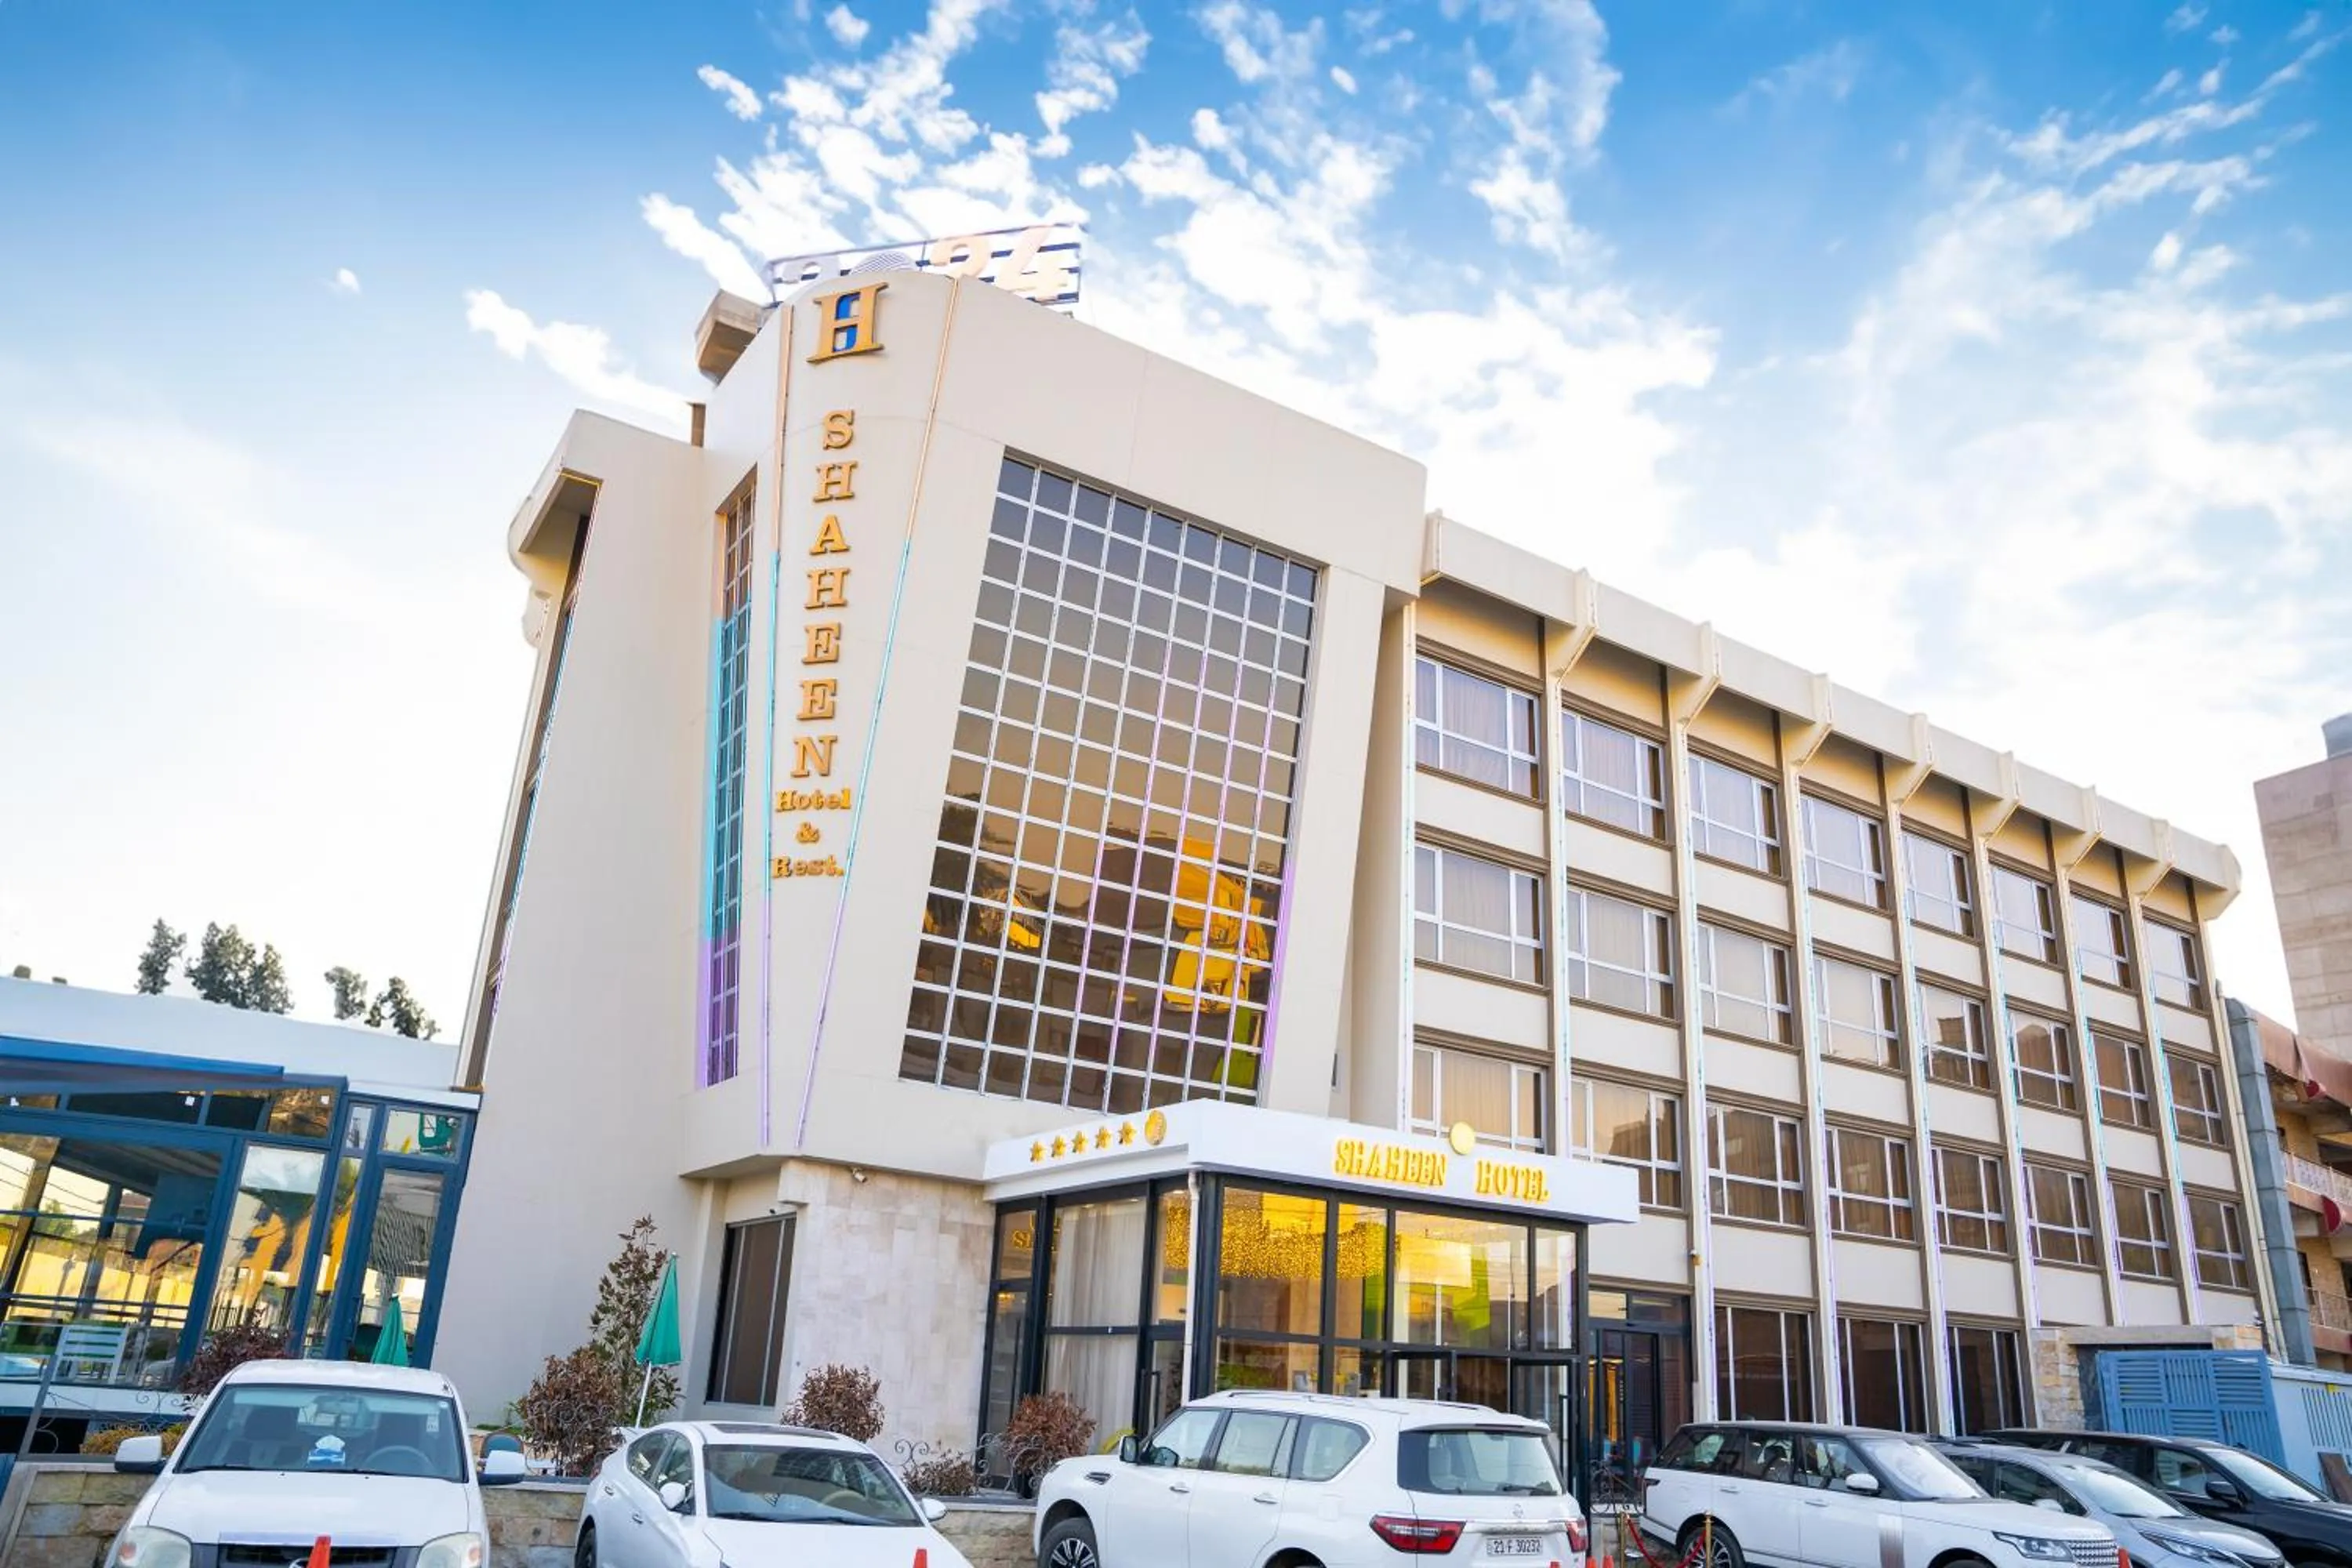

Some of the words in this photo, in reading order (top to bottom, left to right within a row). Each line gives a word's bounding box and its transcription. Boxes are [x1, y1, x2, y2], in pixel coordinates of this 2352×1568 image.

[790, 408, 858, 780] SHAHEEN
[775, 788, 851, 812] Hotel
[796, 822, 820, 844] &
[772, 855, 844, 878] Rest.
[1334, 1139, 1446, 1185] SHAHEEN
[1475, 1160, 1549, 1201] HOTEL
